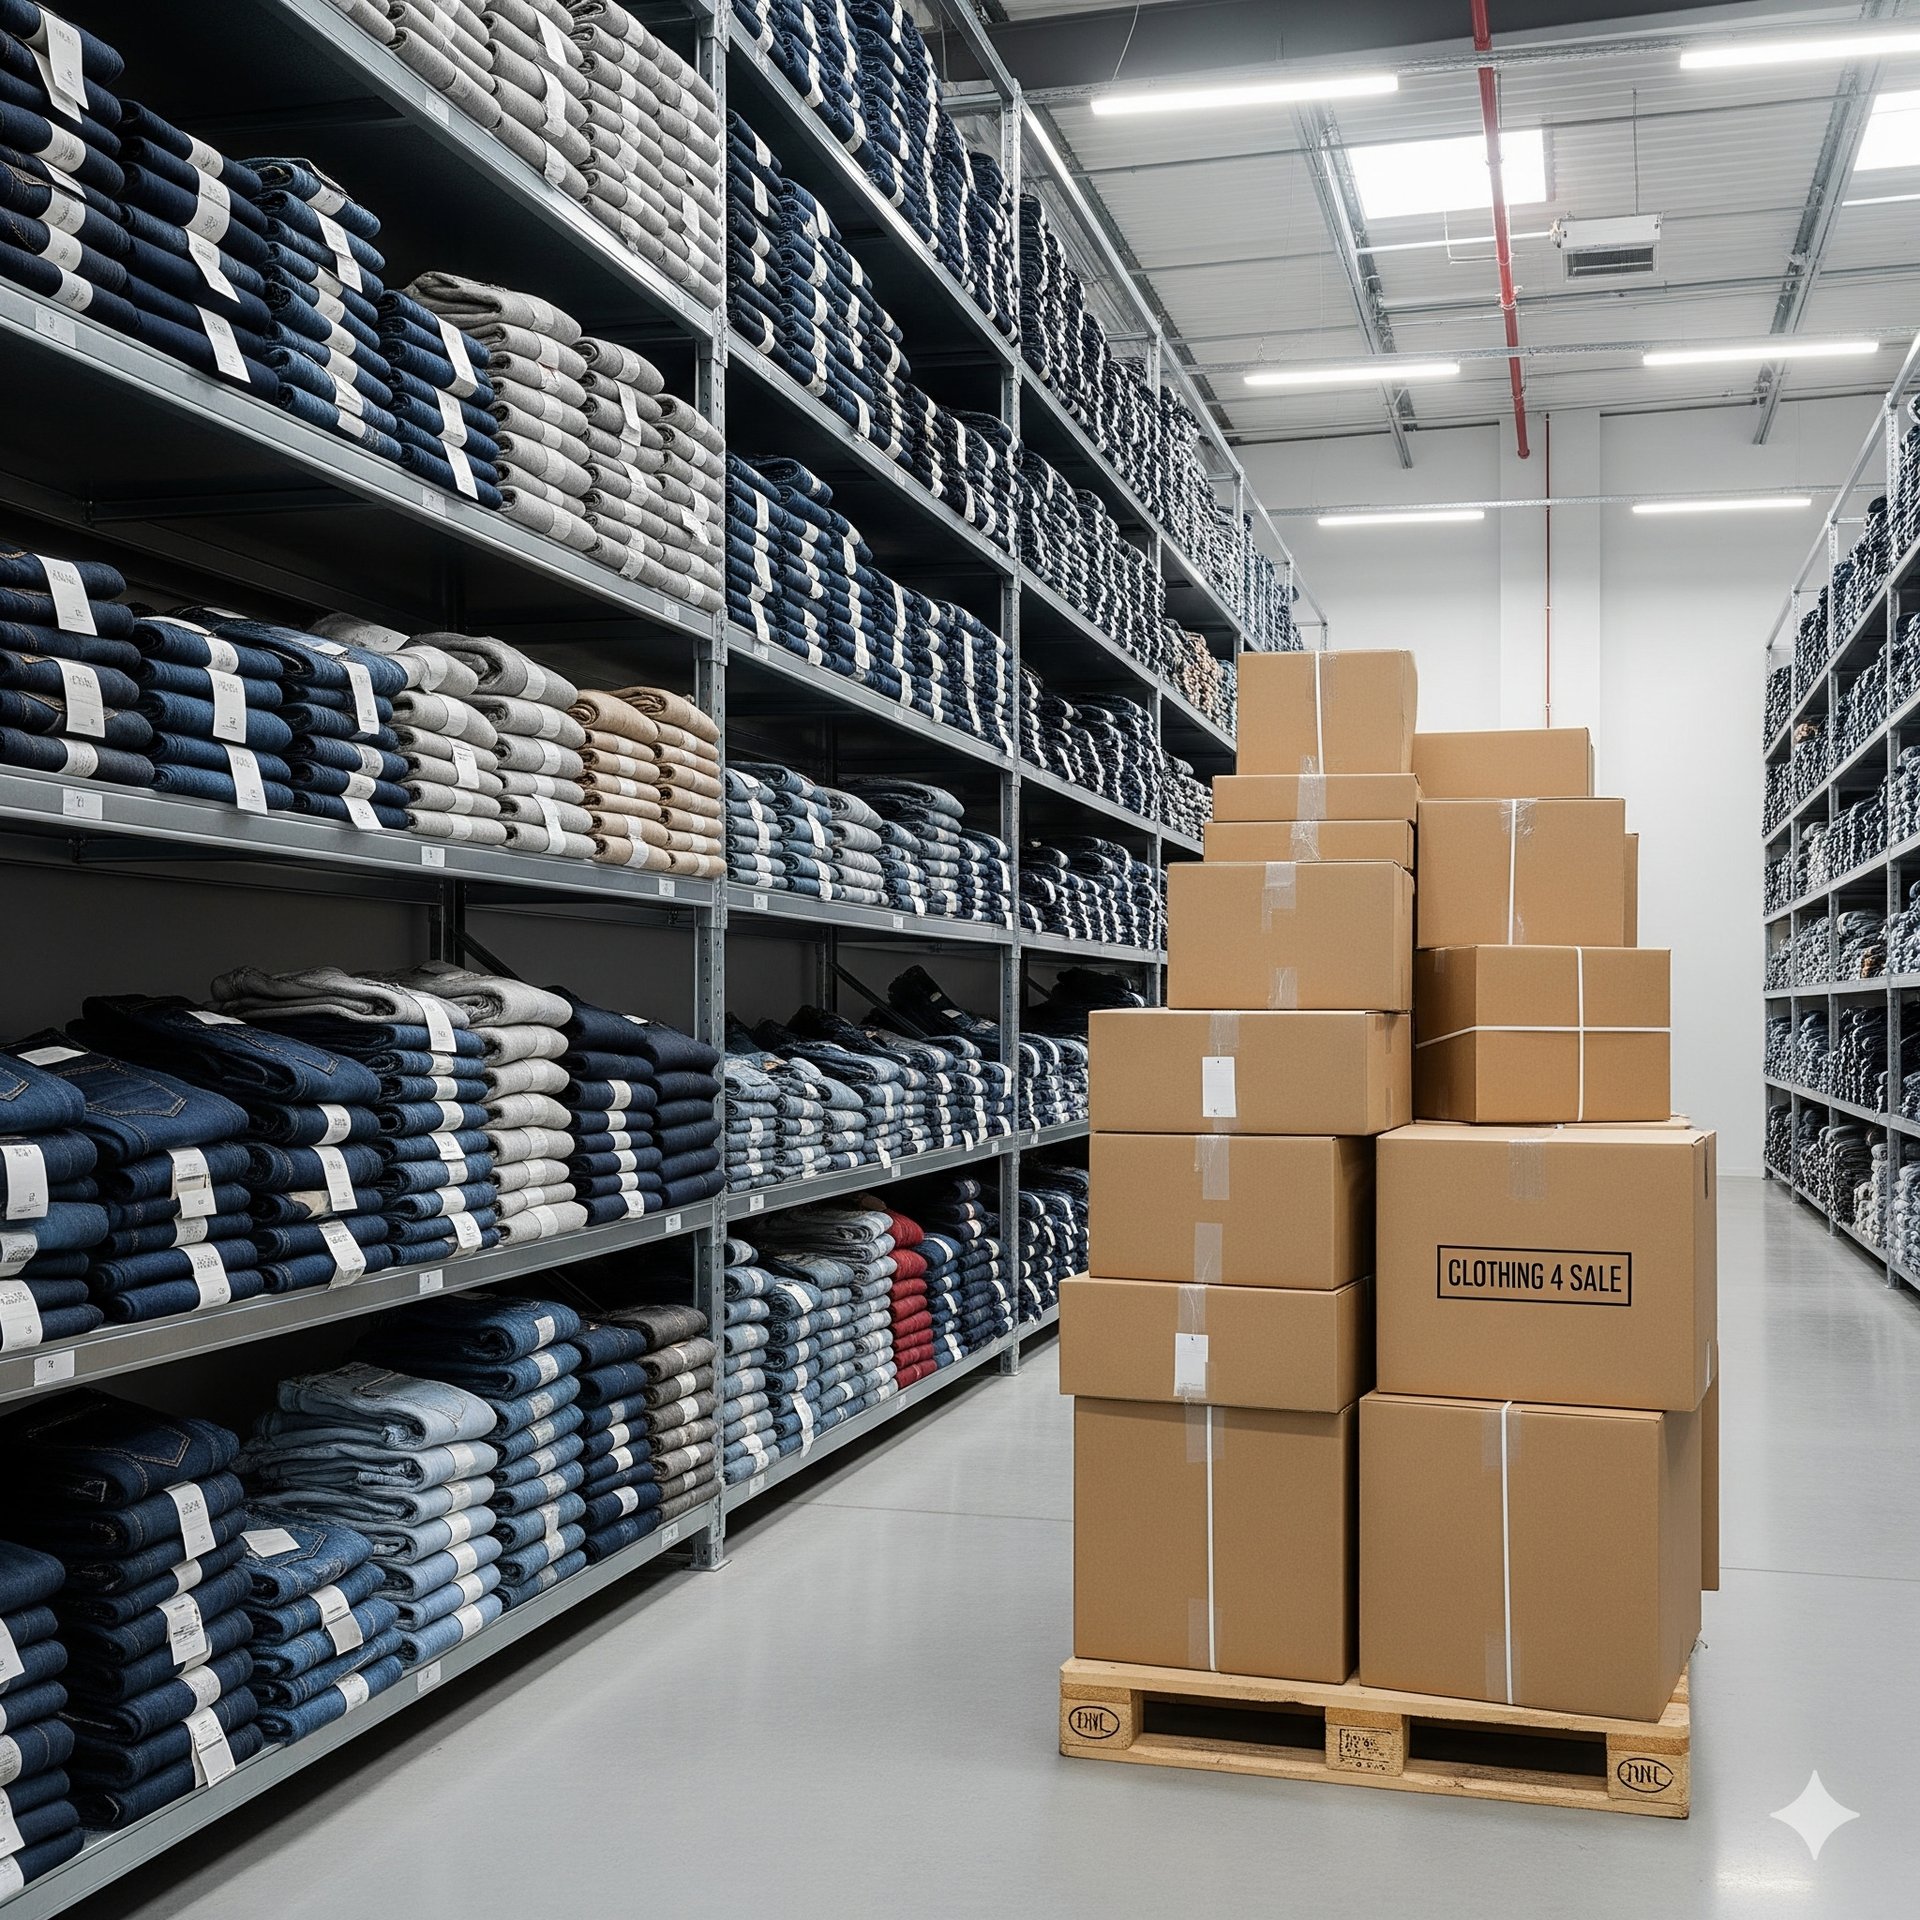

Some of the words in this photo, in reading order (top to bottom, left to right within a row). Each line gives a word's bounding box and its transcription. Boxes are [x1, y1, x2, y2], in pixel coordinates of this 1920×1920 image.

[1448, 1258, 1544, 1290] CLOTHING
[1550, 1263, 1564, 1291] 4
[1569, 1264, 1622, 1293] SALE
